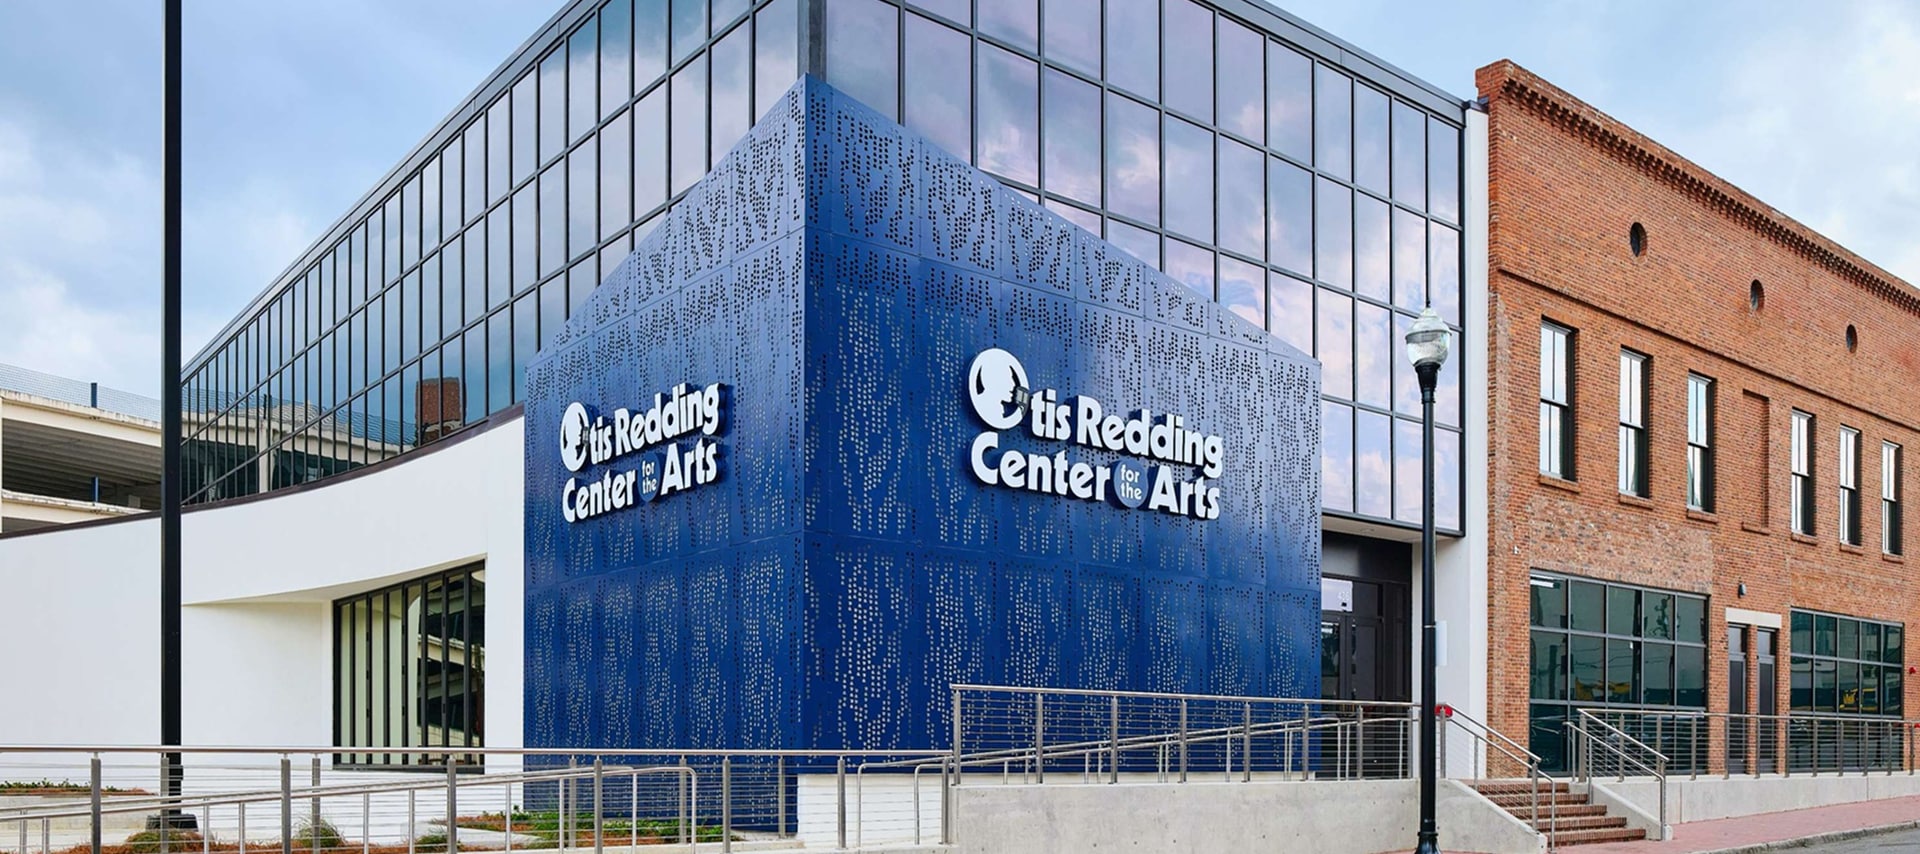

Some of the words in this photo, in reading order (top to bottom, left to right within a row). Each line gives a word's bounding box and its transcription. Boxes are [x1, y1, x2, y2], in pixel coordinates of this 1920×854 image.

[614, 382, 720, 456] Redding
[1076, 394, 1224, 479] Redding
[642, 460, 655, 476] for
[642, 478, 657, 495] the
[660, 437, 717, 496] Arts
[971, 431, 1111, 501] Center
[1120, 484, 1142, 501] the
[1121, 464, 1140, 482] for
[1148, 465, 1221, 520] Arts
[562, 469, 636, 523] Center
